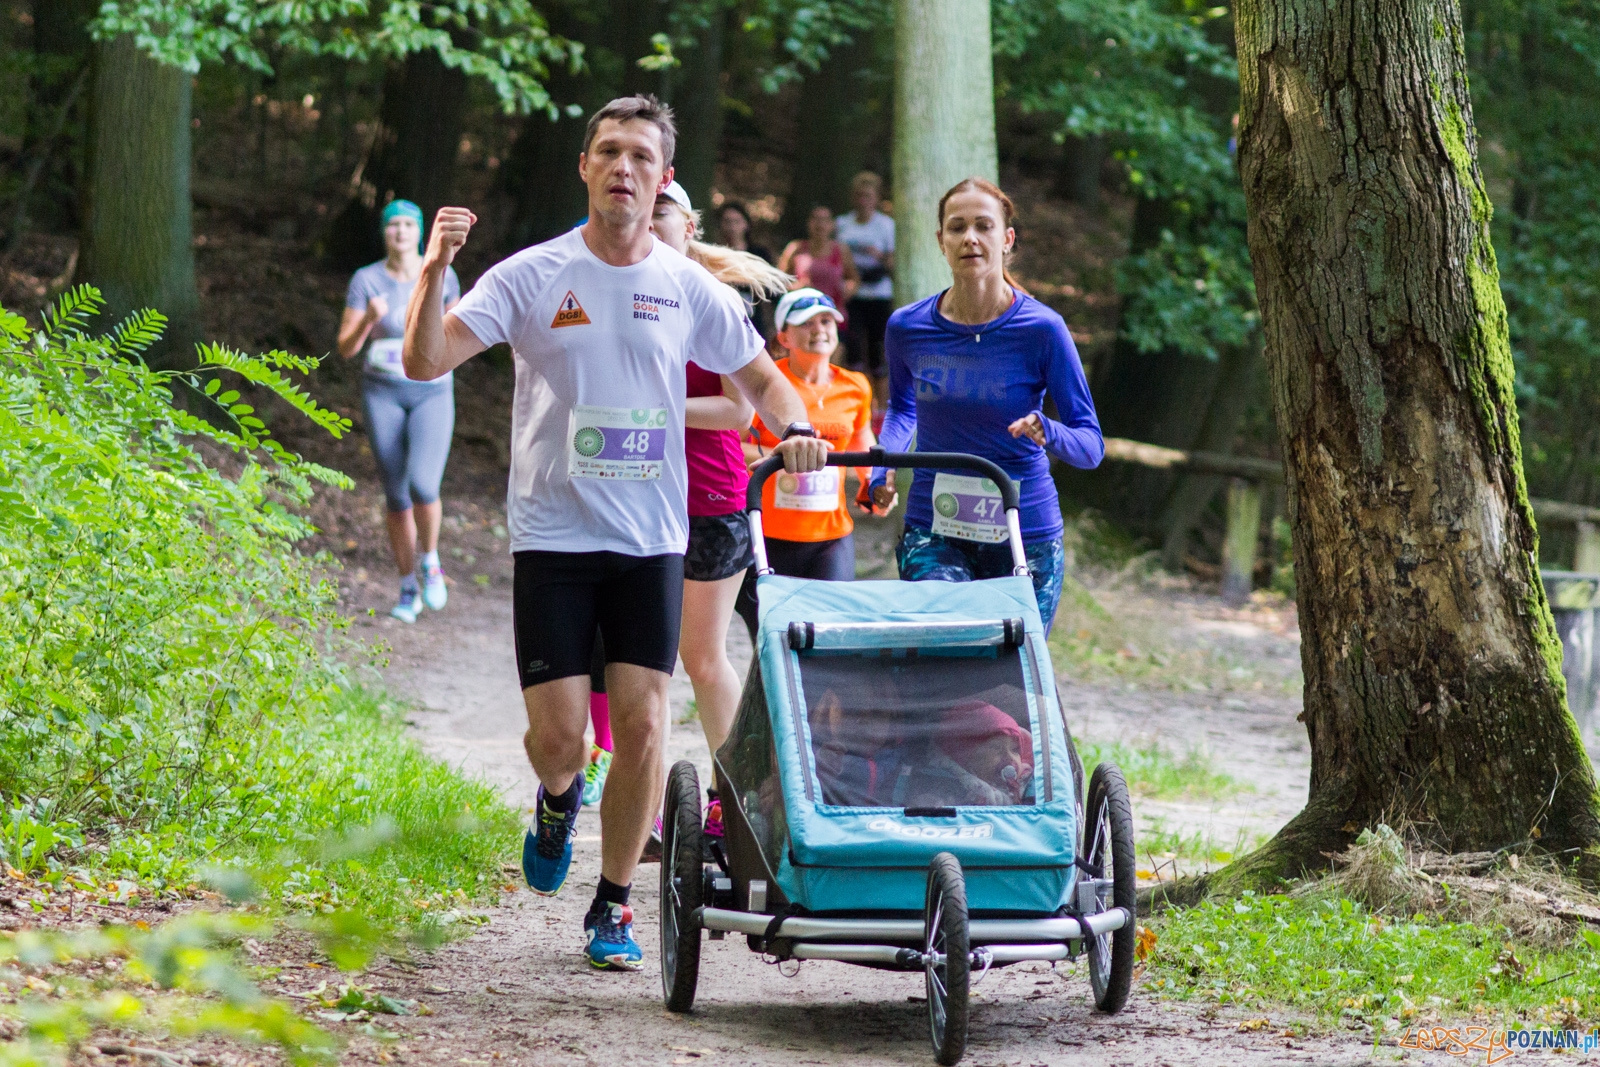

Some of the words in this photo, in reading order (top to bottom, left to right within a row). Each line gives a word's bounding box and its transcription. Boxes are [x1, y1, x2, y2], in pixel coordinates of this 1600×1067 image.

[633, 293, 680, 309] DZIEWICZA
[633, 302, 659, 313] GÓRA
[559, 311, 582, 321] DGB!
[633, 311, 660, 322] BIEGA
[621, 431, 650, 453] 48
[806, 475, 834, 492] 199
[973, 498, 1002, 518] 47
[868, 820, 993, 839] CROOZER
